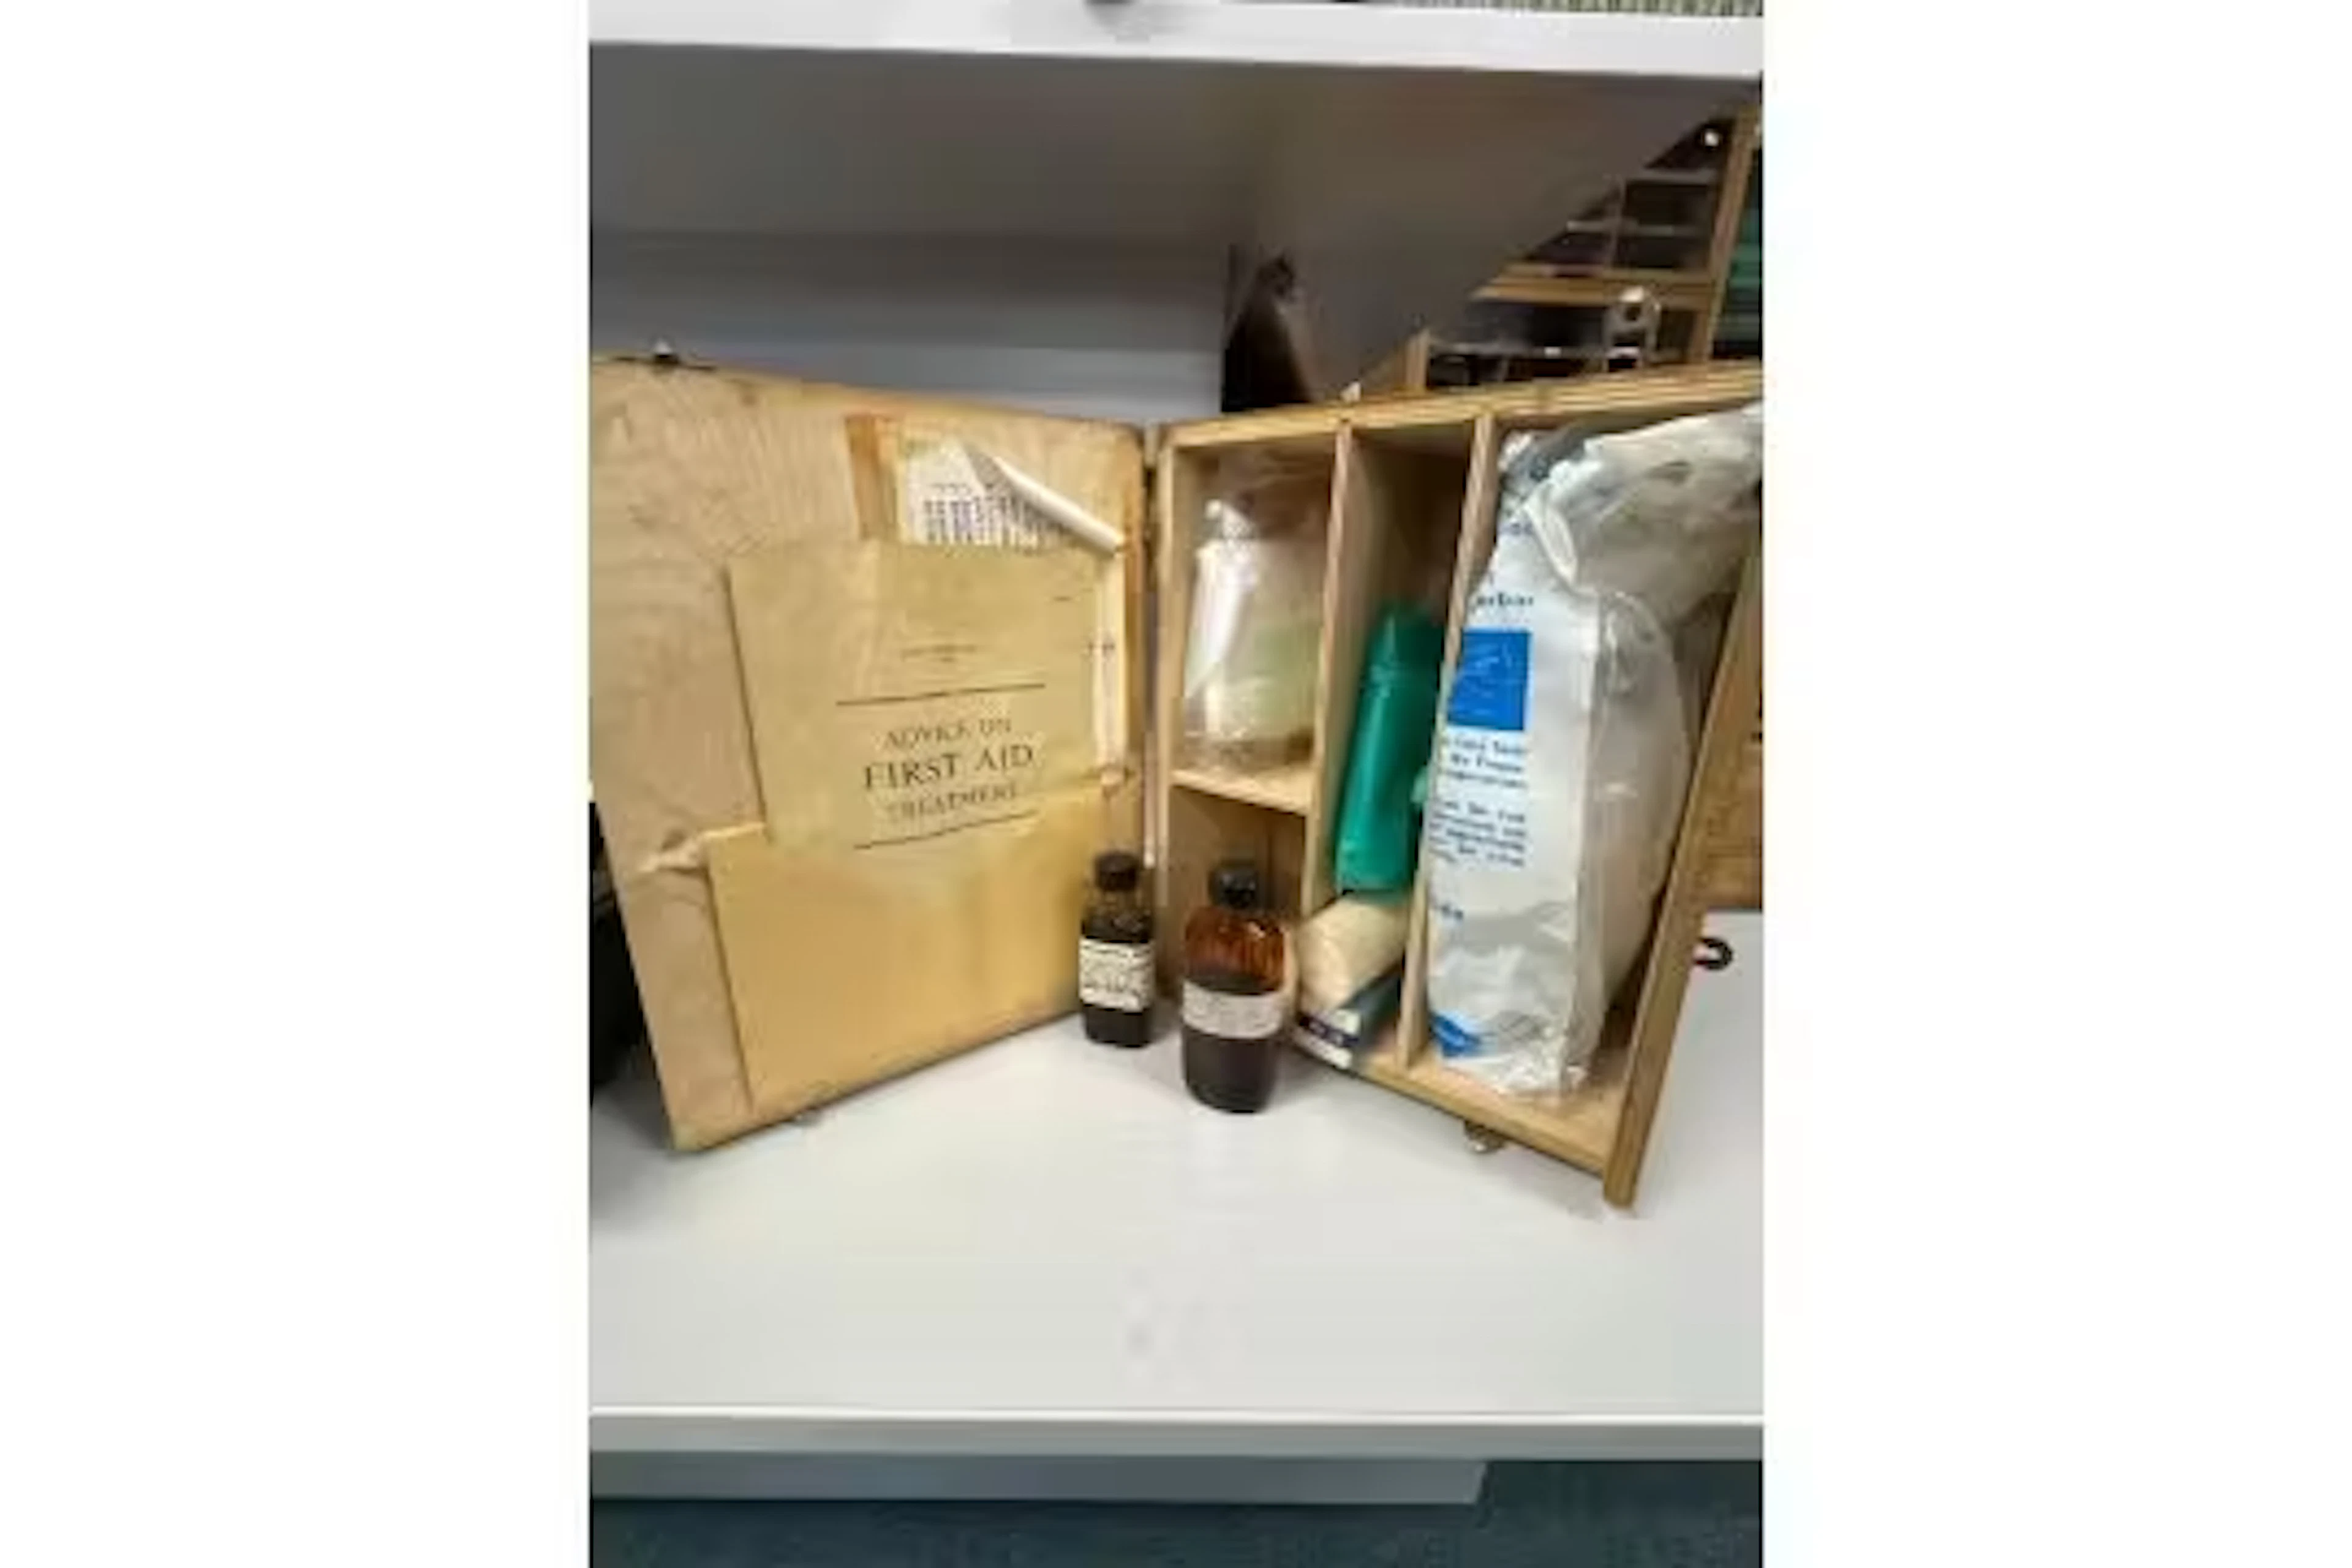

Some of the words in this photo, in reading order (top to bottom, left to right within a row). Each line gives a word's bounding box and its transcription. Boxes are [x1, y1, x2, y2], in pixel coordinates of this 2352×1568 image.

[884, 721, 970, 750] ADVICE
[978, 718, 1012, 736] ON
[864, 752, 960, 790] FIRST
[974, 744, 1033, 771] AID
[886, 783, 1016, 820] TREATMENT
